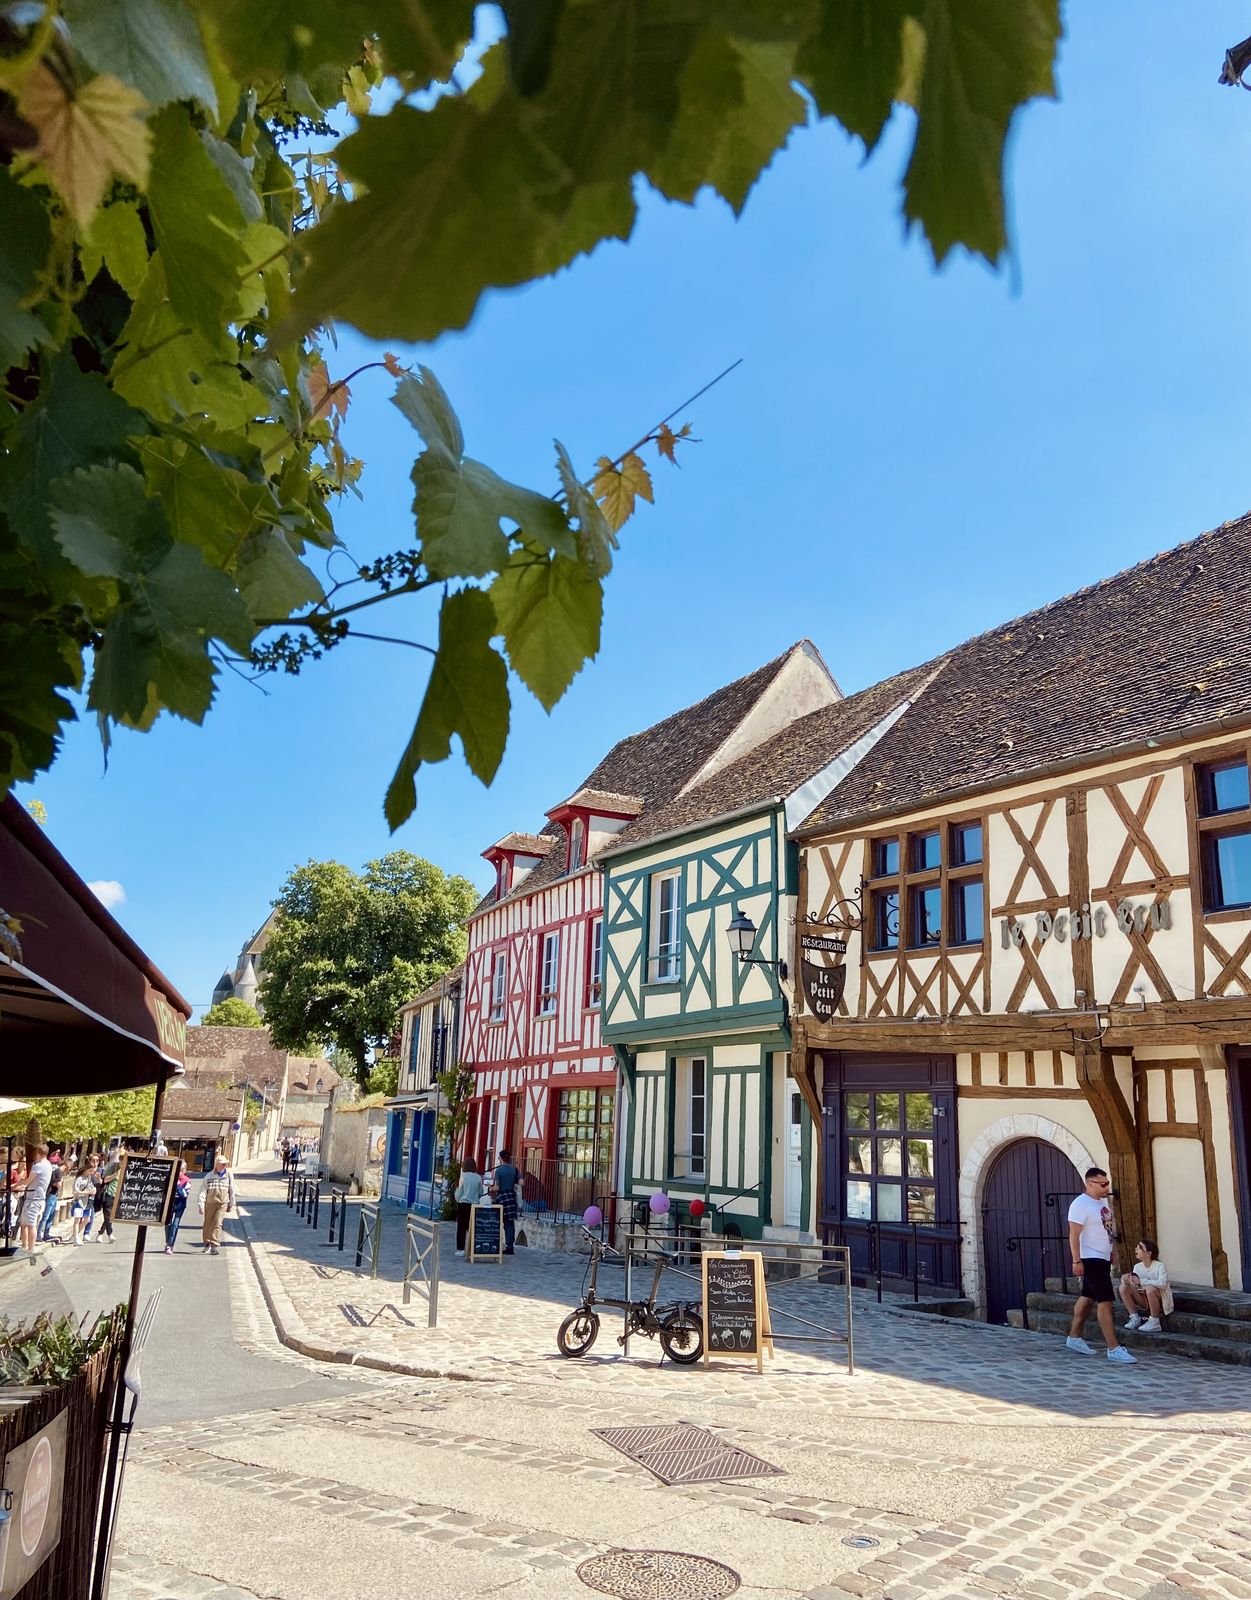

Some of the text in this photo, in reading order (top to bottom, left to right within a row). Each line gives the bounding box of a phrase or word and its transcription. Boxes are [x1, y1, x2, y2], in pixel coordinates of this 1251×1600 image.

[1000, 919, 1024, 950] le
[1035, 903, 1106, 944] Petit
[819, 971, 829, 984] le
[810, 982, 834, 999] Petit
